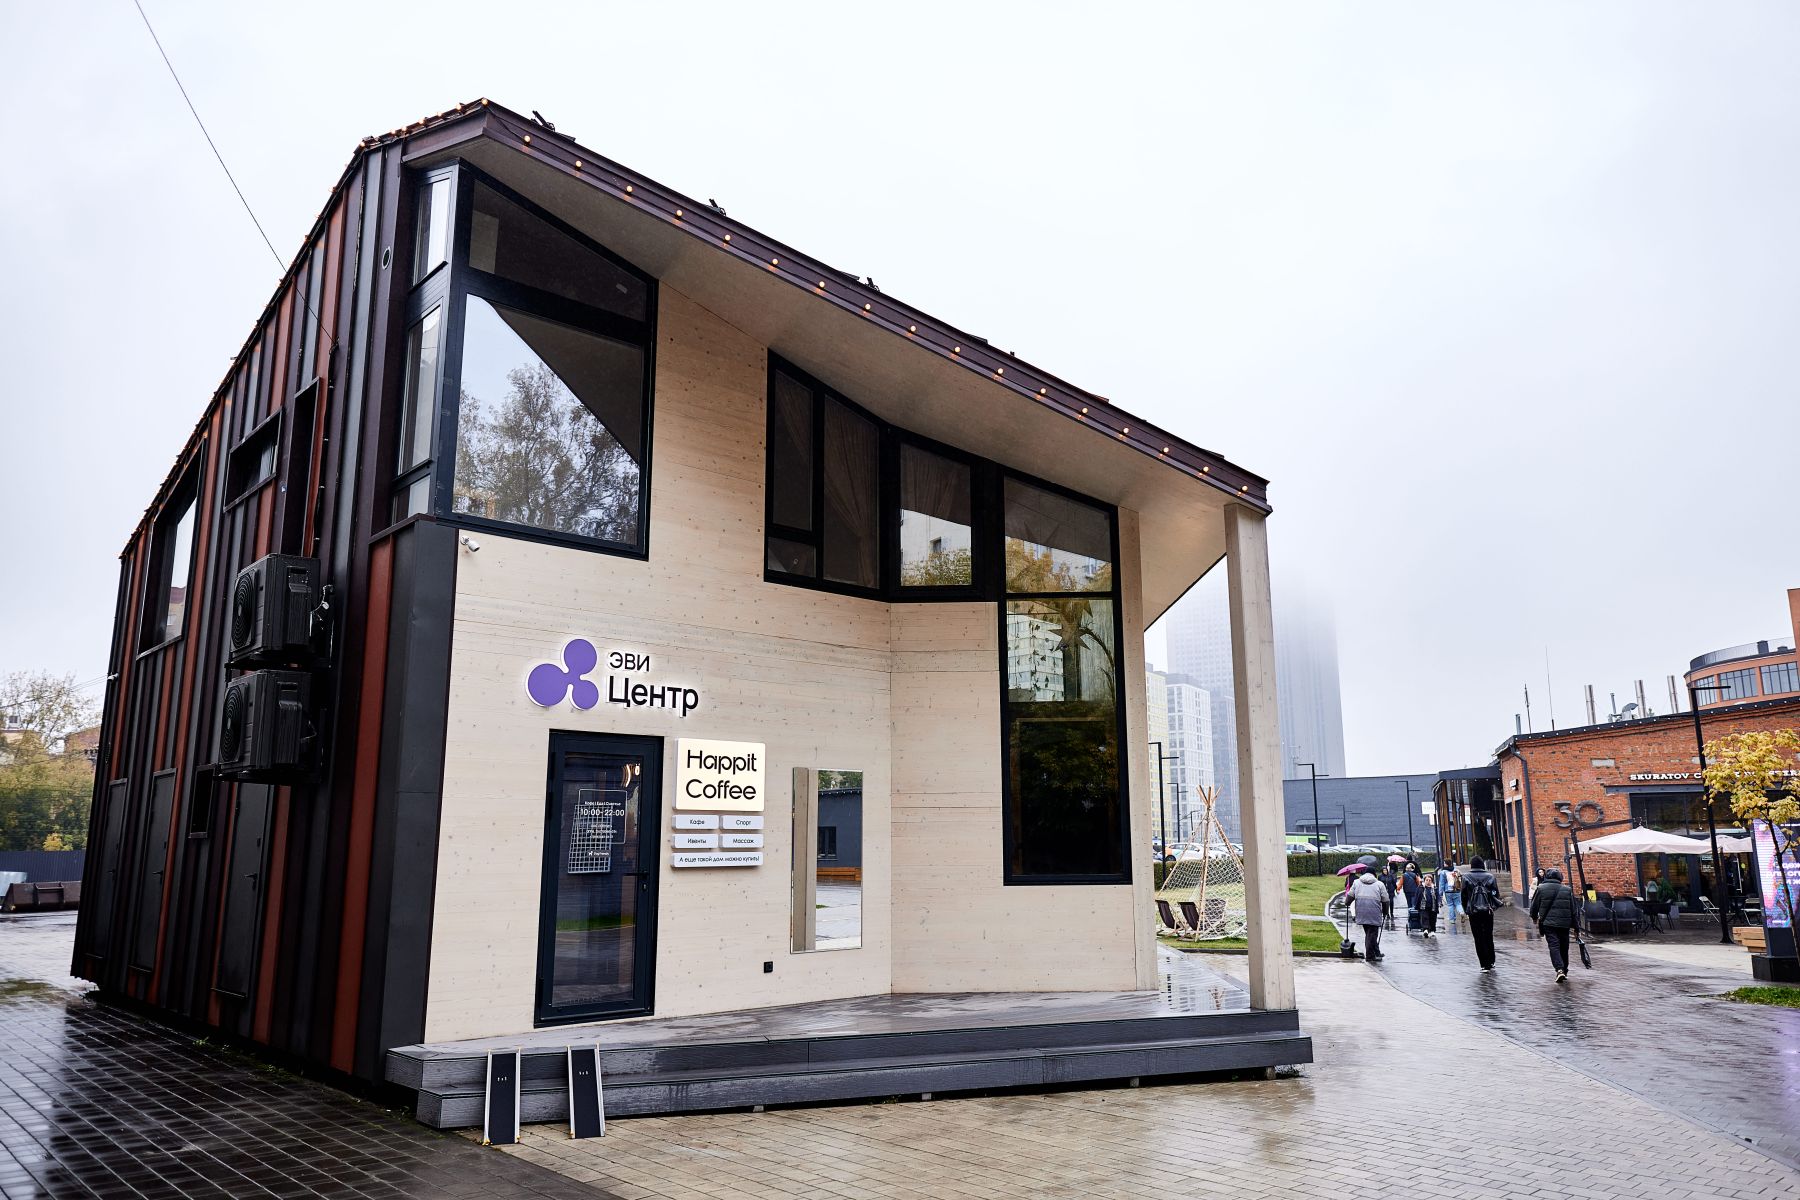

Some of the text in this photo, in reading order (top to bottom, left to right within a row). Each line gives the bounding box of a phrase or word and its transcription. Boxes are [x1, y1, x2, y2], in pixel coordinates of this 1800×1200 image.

[608, 675, 699, 717] Центр
[686, 749, 758, 775] Happit
[685, 778, 757, 800] Coffee
[1629, 773, 1690, 781] SKURATOV
[689, 818, 705, 826] Кафе
[1552, 799, 1605, 828] 30
